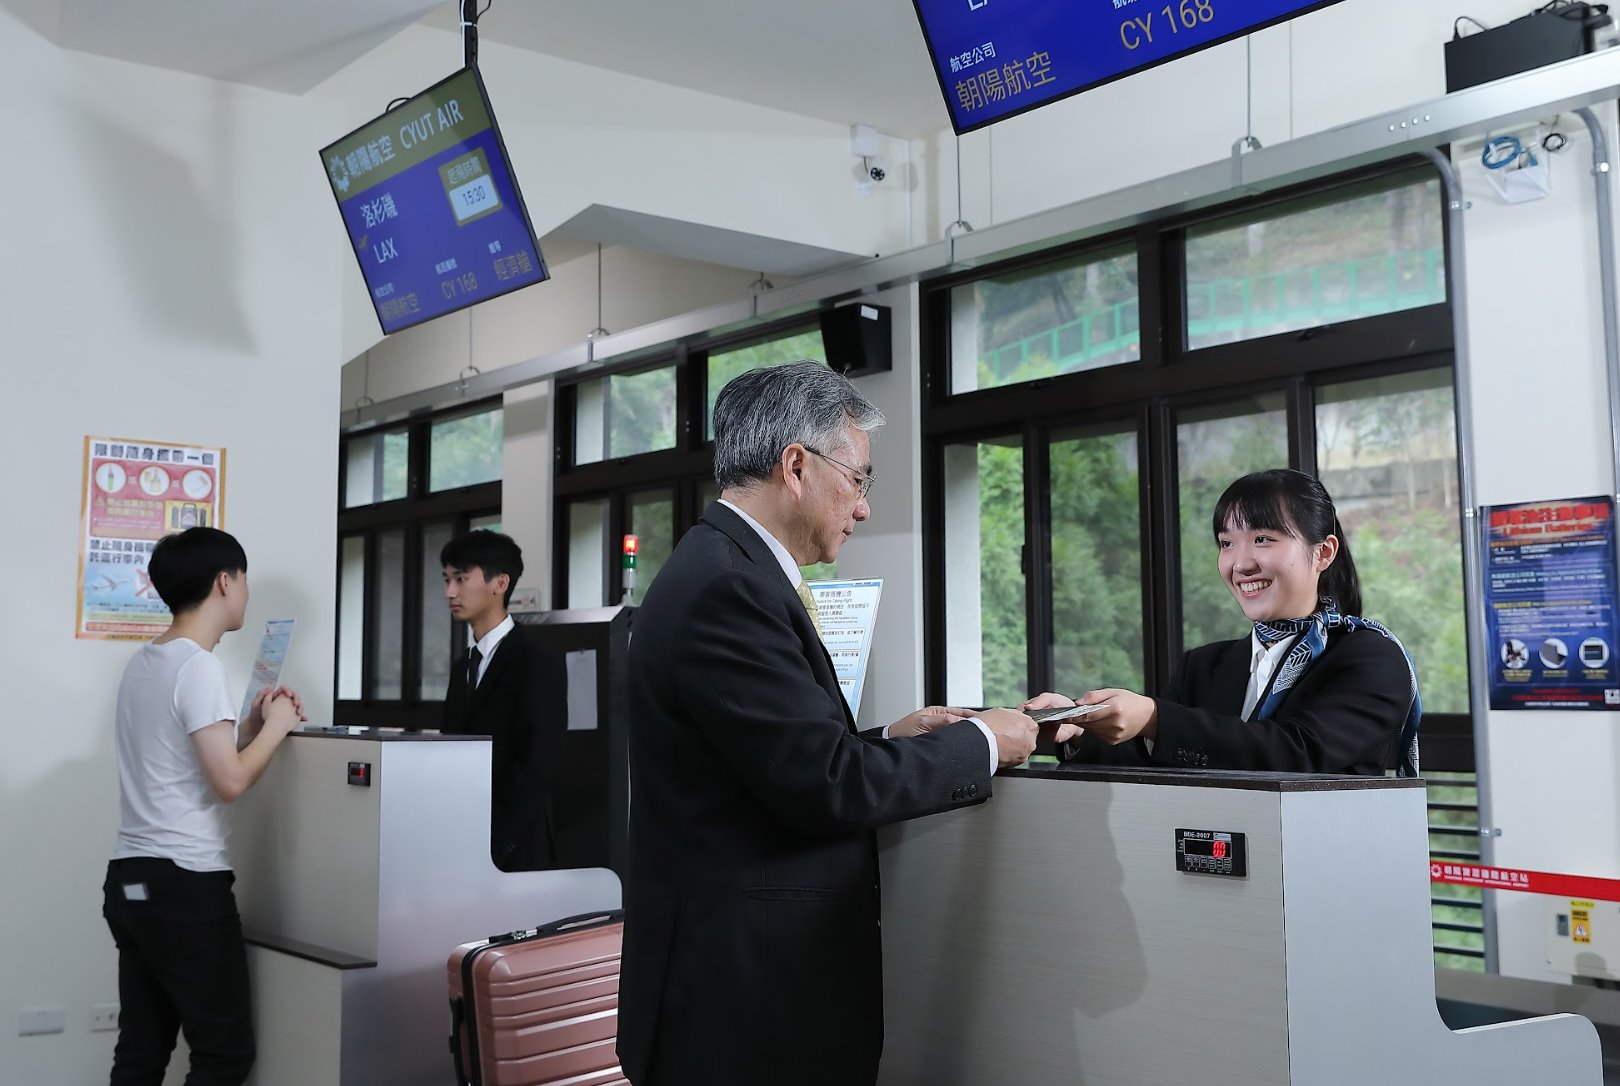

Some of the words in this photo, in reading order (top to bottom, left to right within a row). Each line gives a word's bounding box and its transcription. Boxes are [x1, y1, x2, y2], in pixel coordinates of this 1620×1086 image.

[1119, 12, 1153, 50] CY
[1161, 0, 1215, 34] 168
[949, 40, 997, 73] 航空公司
[955, 50, 1056, 113] 朝陽航空
[346, 134, 396, 178] 朝陽航空
[400, 113, 435, 150] CYUT
[436, 99, 464, 128] AIR
[360, 192, 398, 229] 洛杉磯
[462, 185, 486, 206] 15:30
[373, 237, 399, 264] LAX
[441, 278, 456, 300] CY
[456, 271, 478, 297] 168
